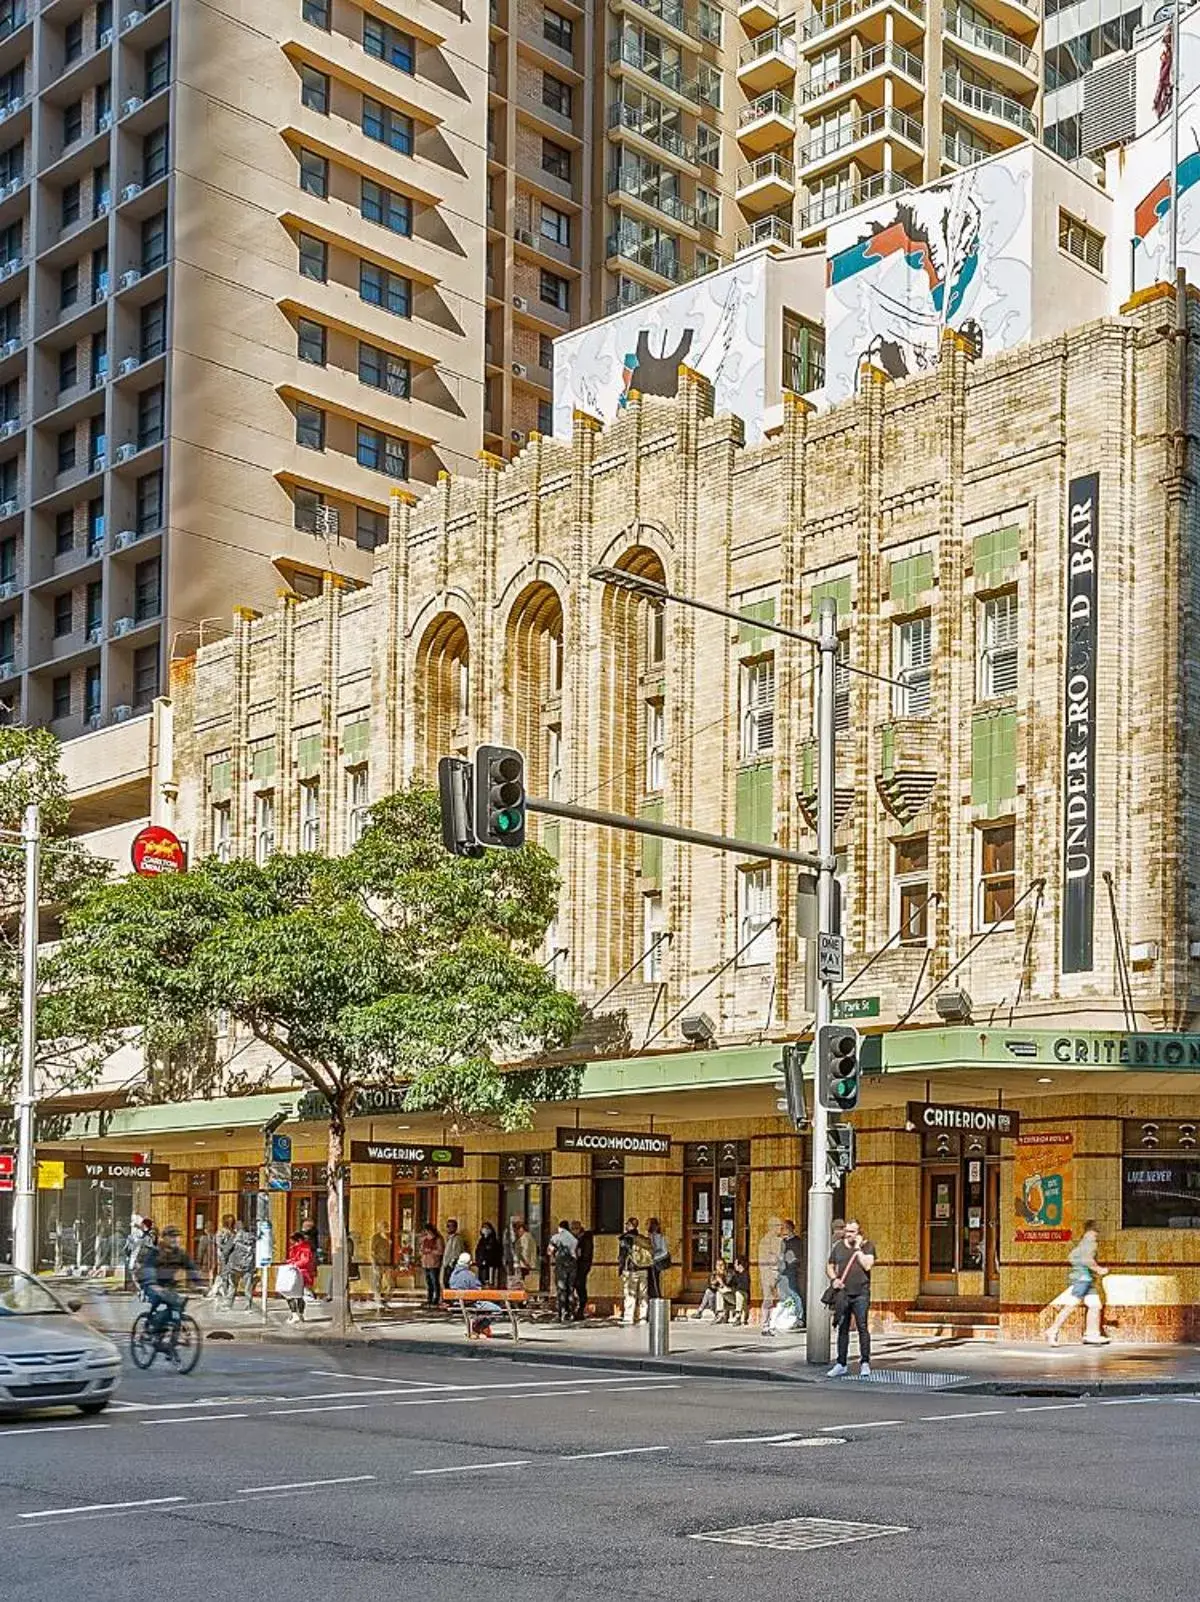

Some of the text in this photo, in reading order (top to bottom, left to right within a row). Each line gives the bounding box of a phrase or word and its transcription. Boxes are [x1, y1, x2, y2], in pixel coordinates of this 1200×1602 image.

[1067, 497, 1094, 881] UNDERGROUND BAR
[822, 937, 840, 950] ONE
[821, 951, 841, 965] WAY
[924, 1108, 996, 1130] CRITERION
[575, 1135, 669, 1152] ACCOMMODATION
[368, 1146, 425, 1161] WAGERING
[86, 1164, 151, 1178] VIP LOUNGE
